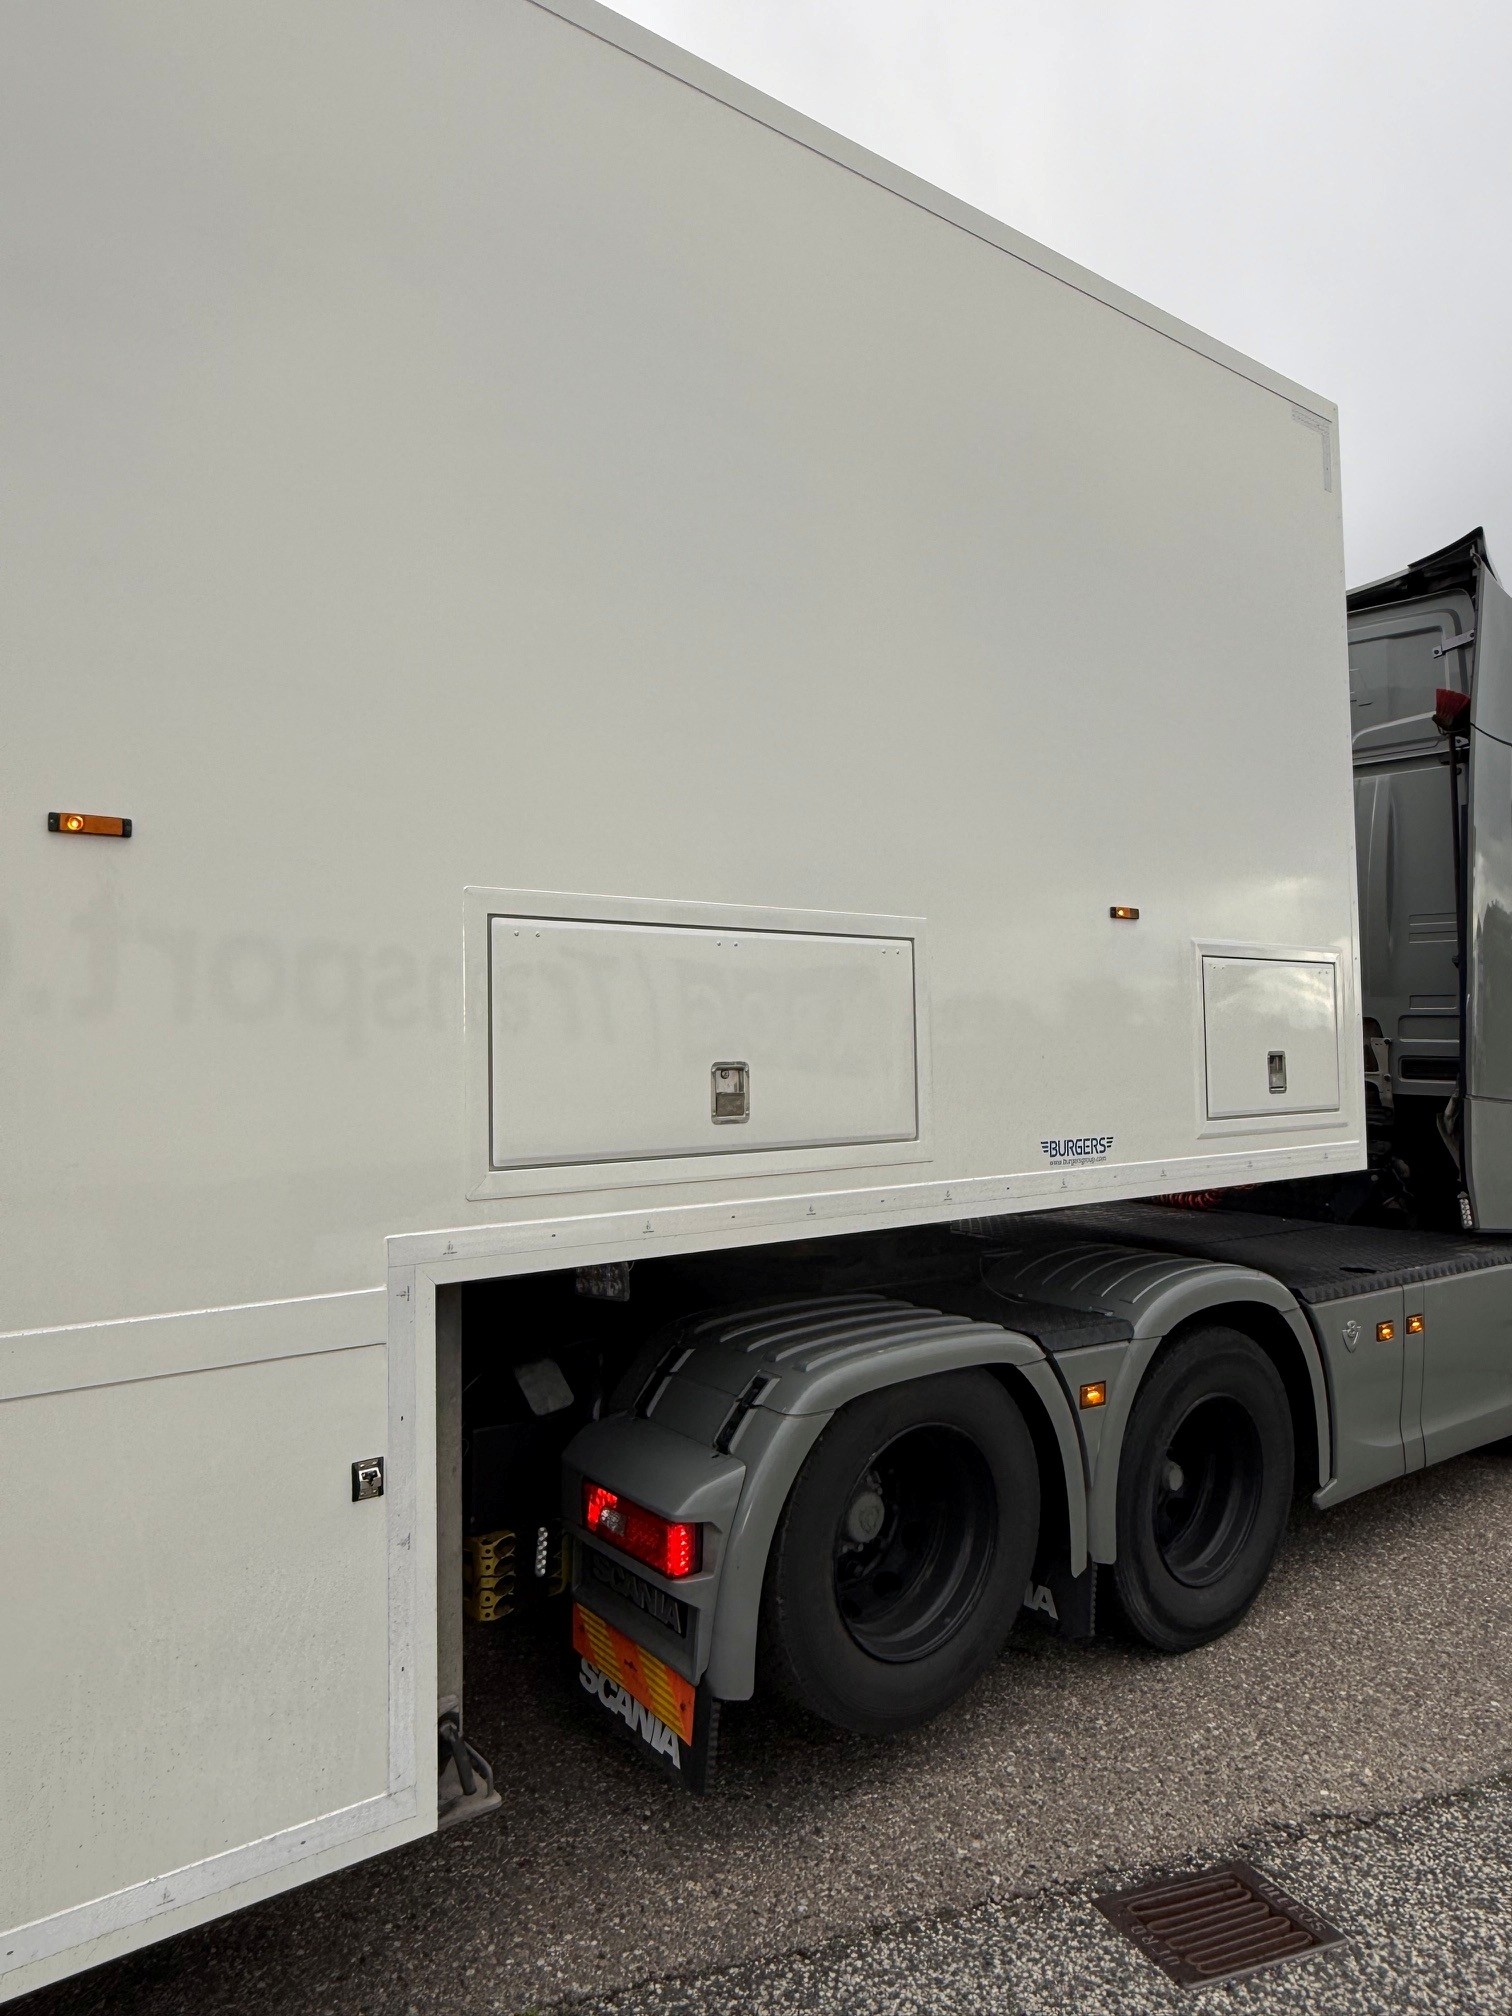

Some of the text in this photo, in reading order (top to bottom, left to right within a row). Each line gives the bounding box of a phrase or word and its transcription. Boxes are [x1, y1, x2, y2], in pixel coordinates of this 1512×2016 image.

[1049, 1136, 1107, 1158] BURGERS
[592, 1553, 682, 1635] SCANIA
[579, 1657, 681, 1770] SCANIA
